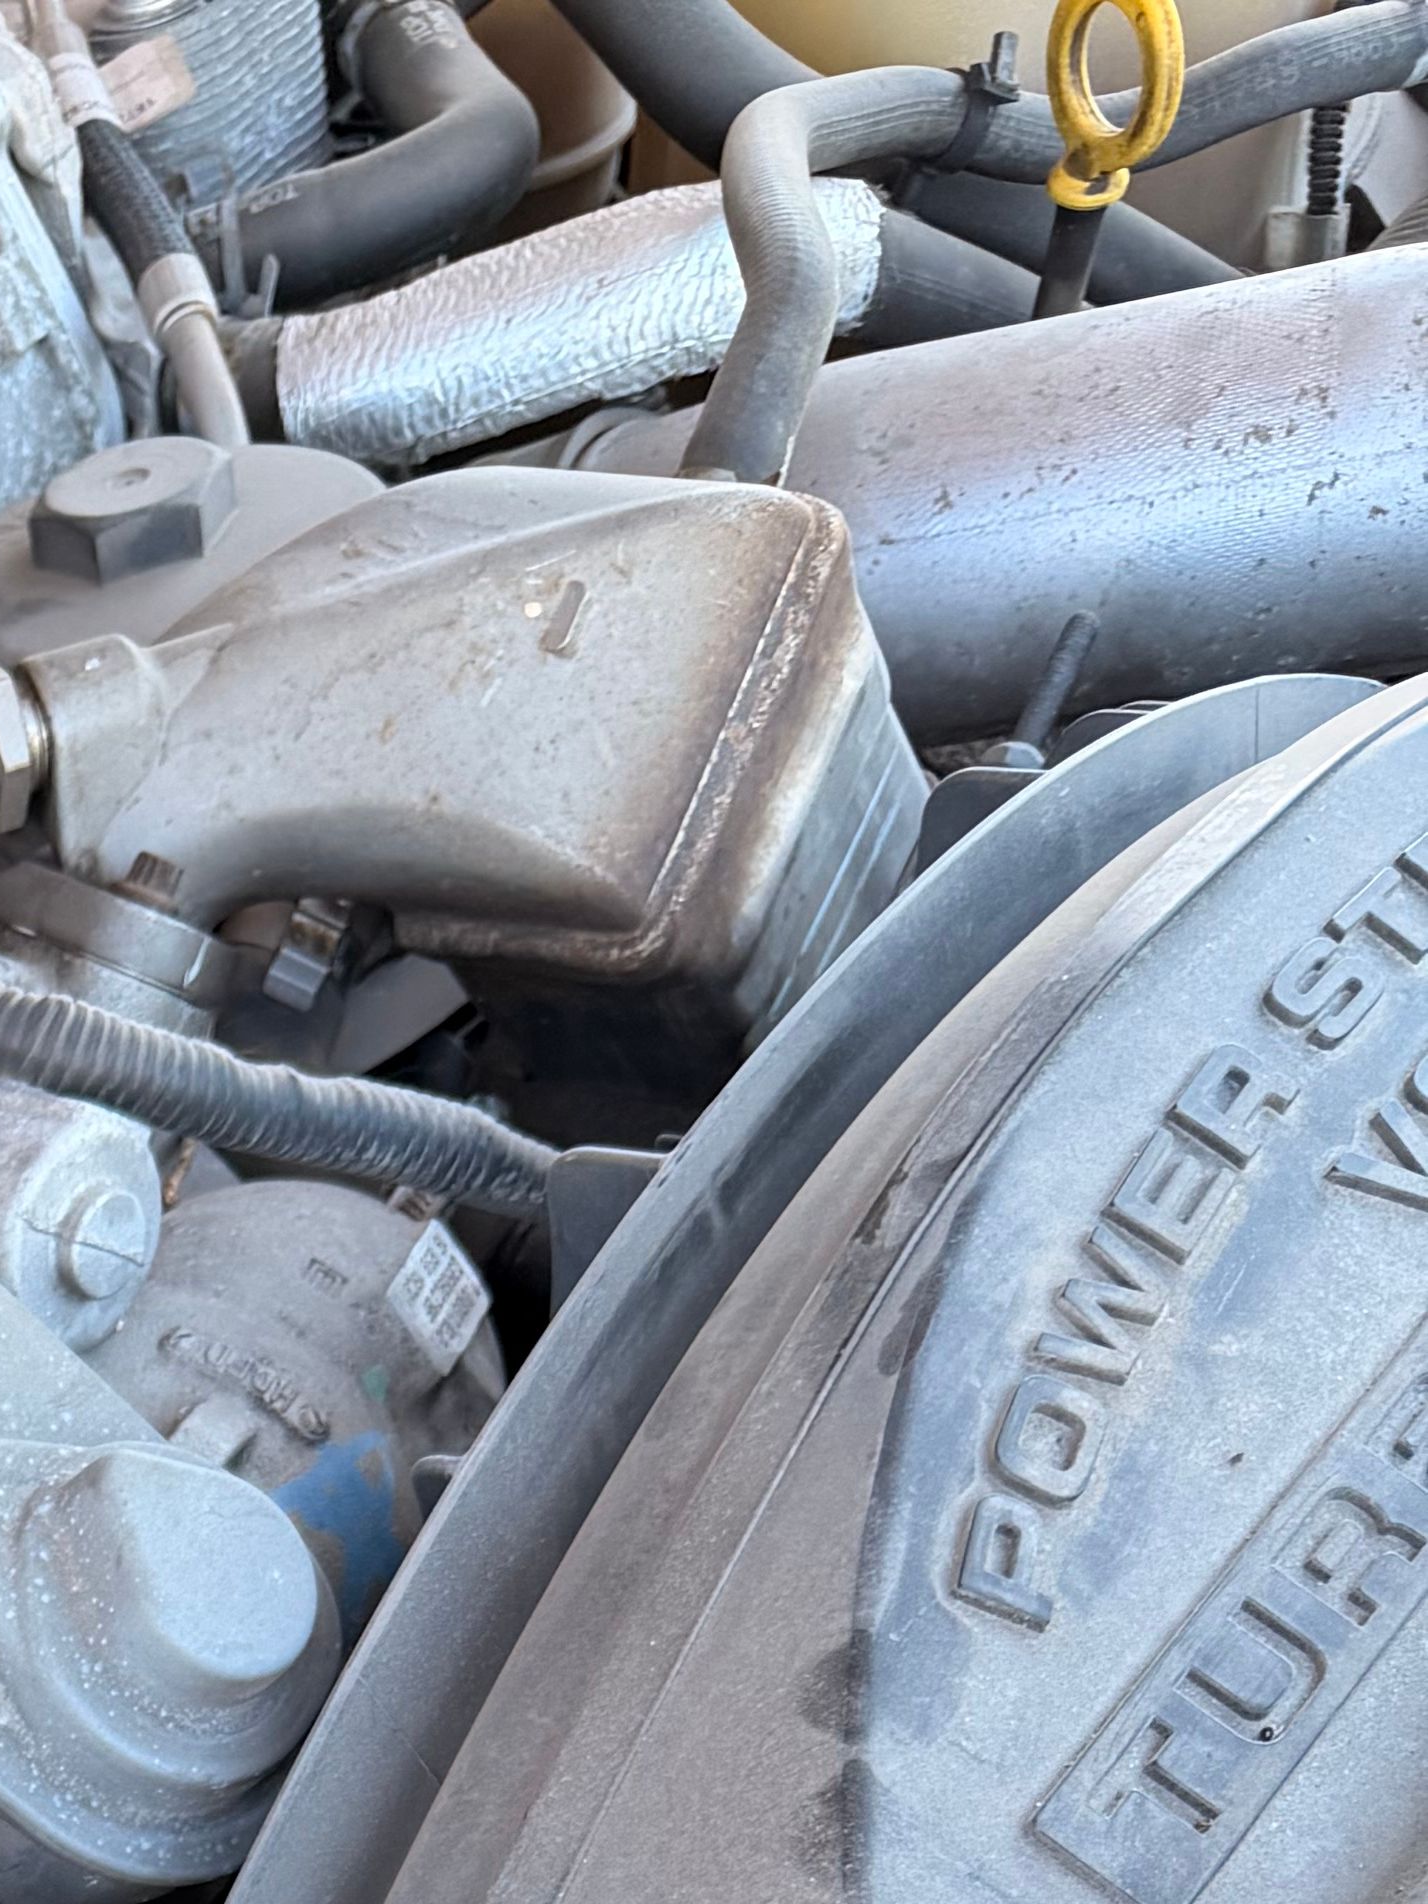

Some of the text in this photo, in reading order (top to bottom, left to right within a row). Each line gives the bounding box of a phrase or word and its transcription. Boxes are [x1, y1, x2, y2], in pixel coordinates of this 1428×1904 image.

[947, 832, 1428, 1634] POWER ST
[1322, 1055, 1428, 1210] V
